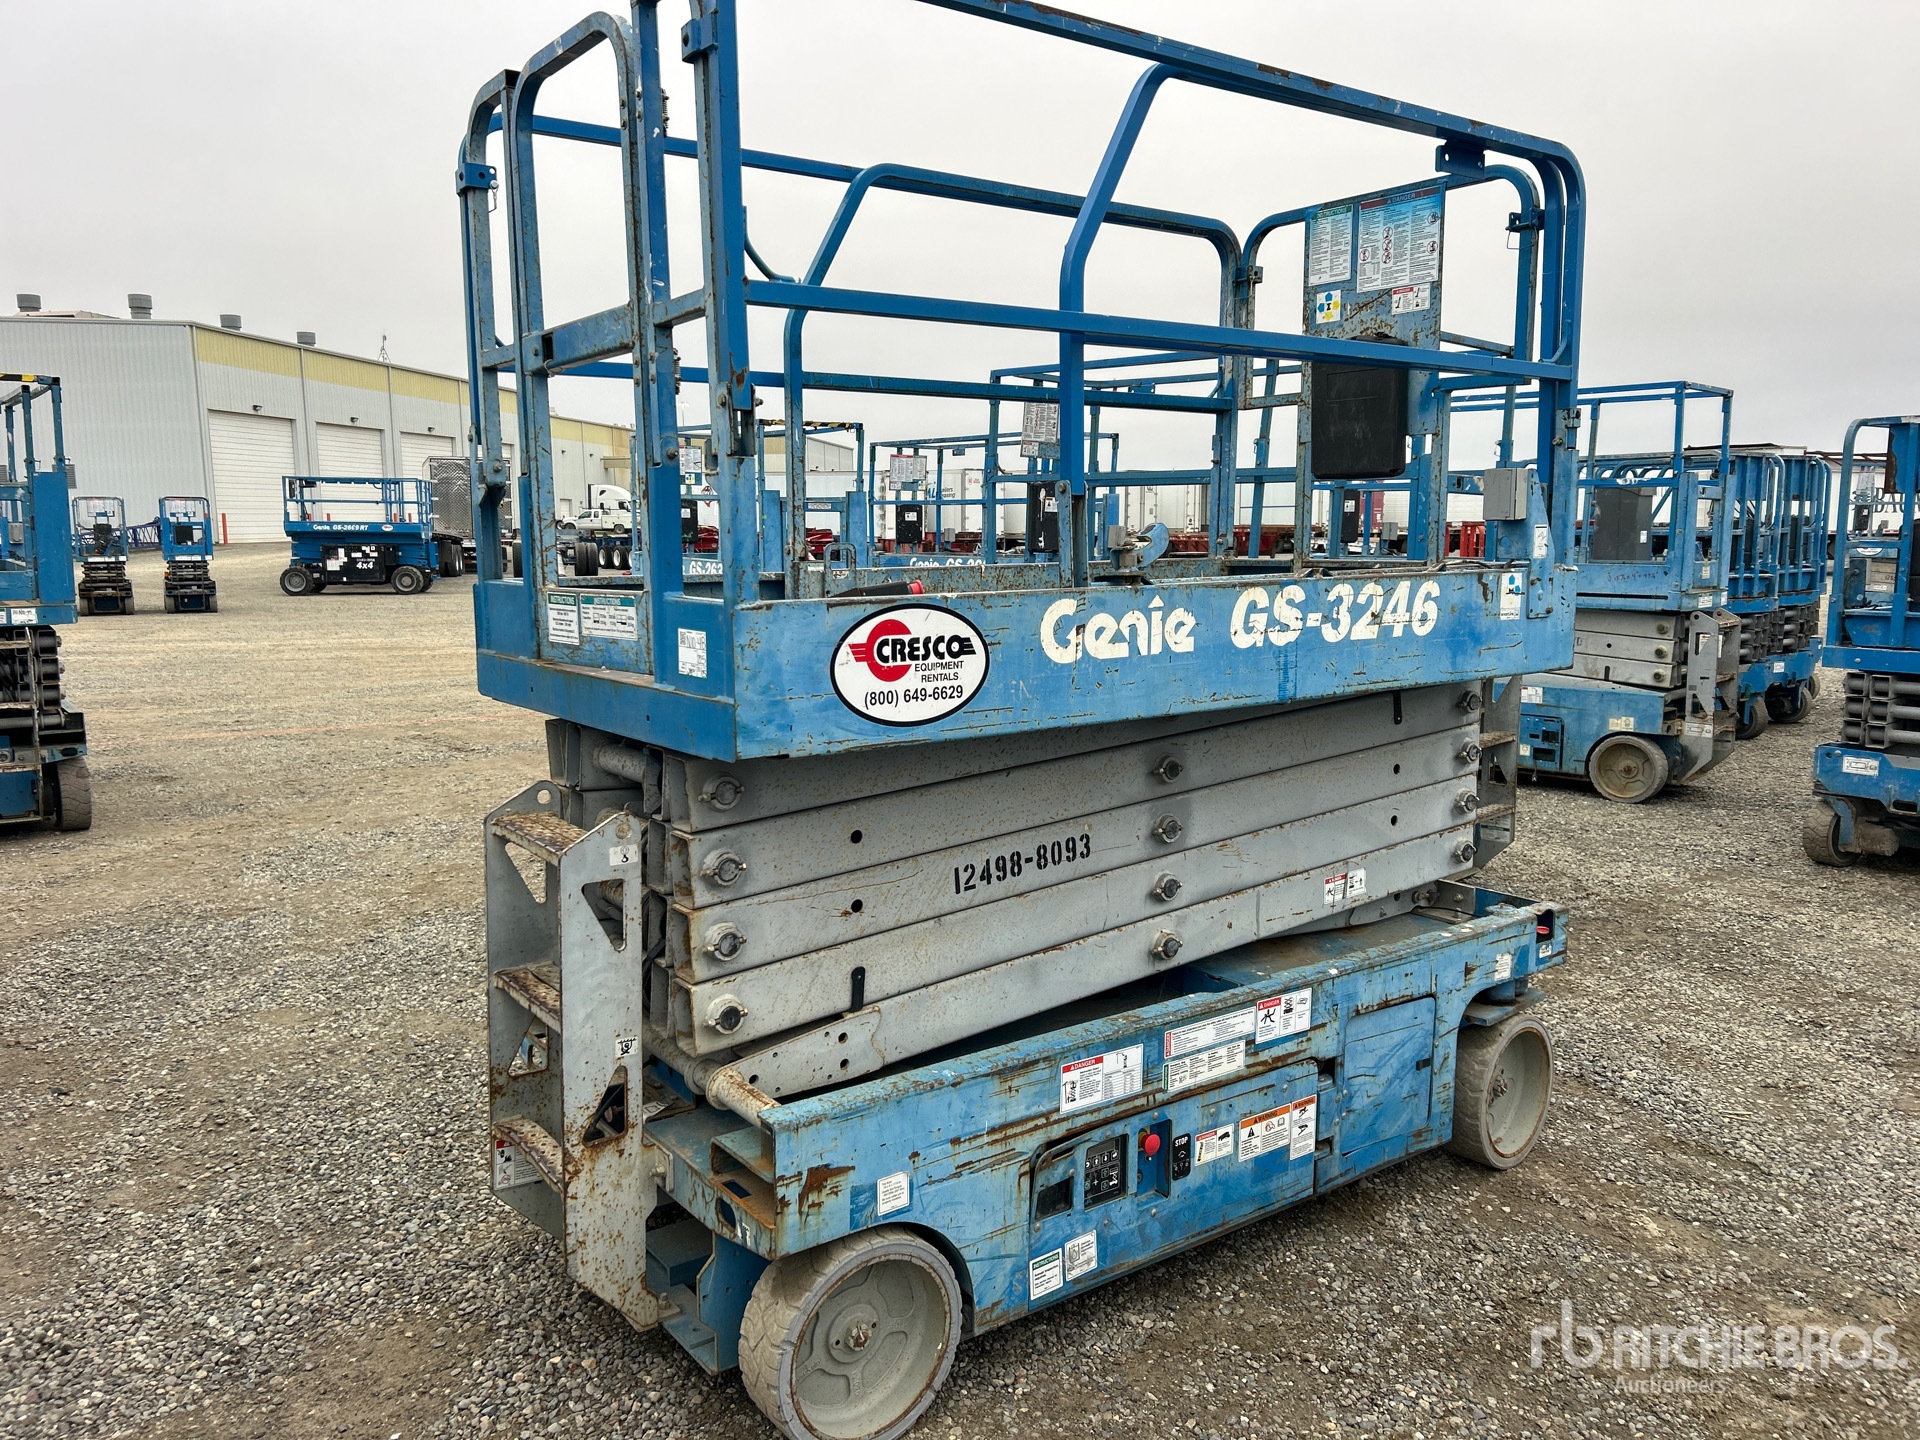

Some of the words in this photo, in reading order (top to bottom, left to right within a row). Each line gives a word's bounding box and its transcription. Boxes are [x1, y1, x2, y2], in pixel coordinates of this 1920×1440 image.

[356, 561, 374, 570] 4x4
[1041, 595, 1196, 664] Genie
[1230, 580, 1441, 649] GS-3246
[876, 634, 976, 664] CRESCO
[915, 661, 965, 672] EQUIPMENT
[921, 672, 960, 683] RENTALS
[864, 689, 899, 710] (800)
[904, 685, 964, 703] 649-6629
[954, 833, 1091, 895] 12498-8093
[1074, 1059, 1096, 1070] DANGER
[1174, 1136, 1189, 1148] STOP
